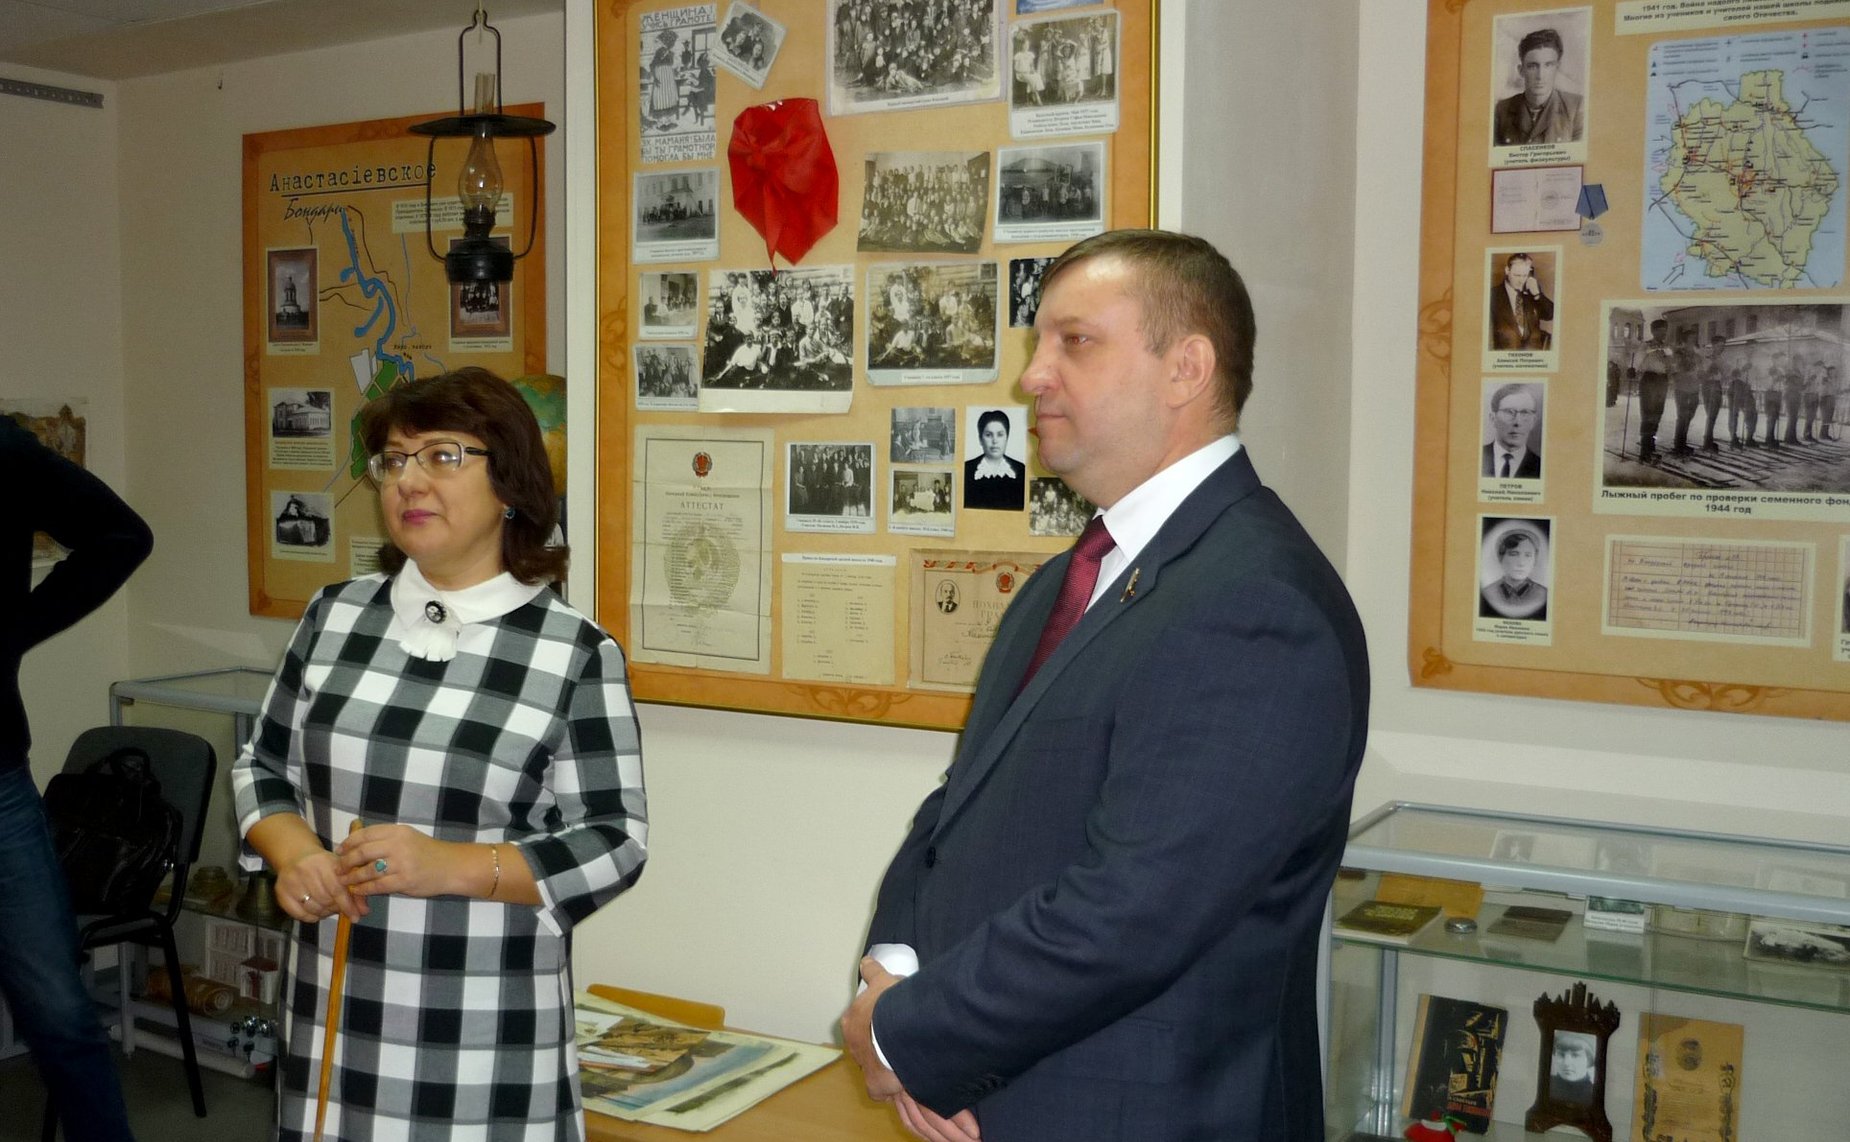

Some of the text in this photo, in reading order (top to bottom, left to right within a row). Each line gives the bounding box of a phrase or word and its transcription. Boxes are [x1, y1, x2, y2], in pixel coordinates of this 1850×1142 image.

[1601, 490, 1647, 499] Лыжный
[1650, 491, 1687, 501] пробег
[1706, 495, 1757, 503] проверки
[1761, 496, 1822, 504] семенного
[1706, 504, 1752, 514] 1944 год
